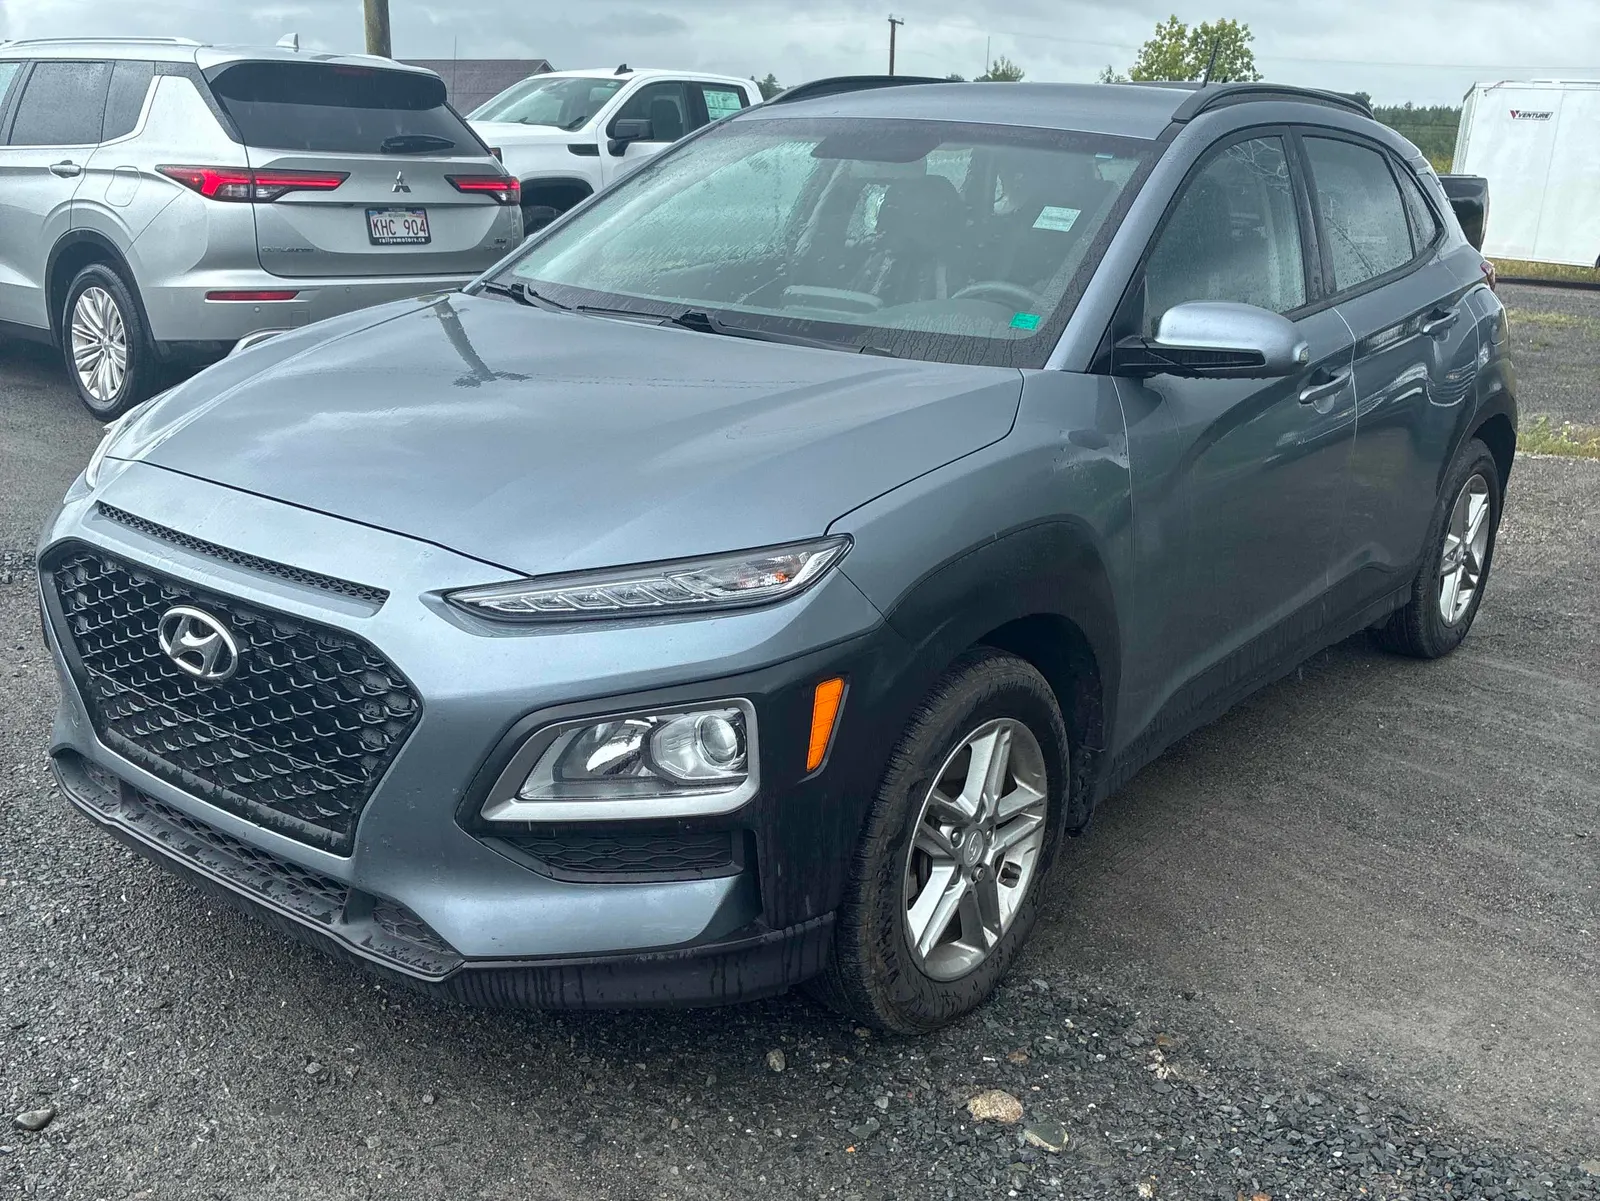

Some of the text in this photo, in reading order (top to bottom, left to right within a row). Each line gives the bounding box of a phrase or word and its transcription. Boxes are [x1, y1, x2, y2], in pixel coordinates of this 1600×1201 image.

[1518, 111, 1550, 119] VENTURE
[372, 219, 427, 236] KHC 904
